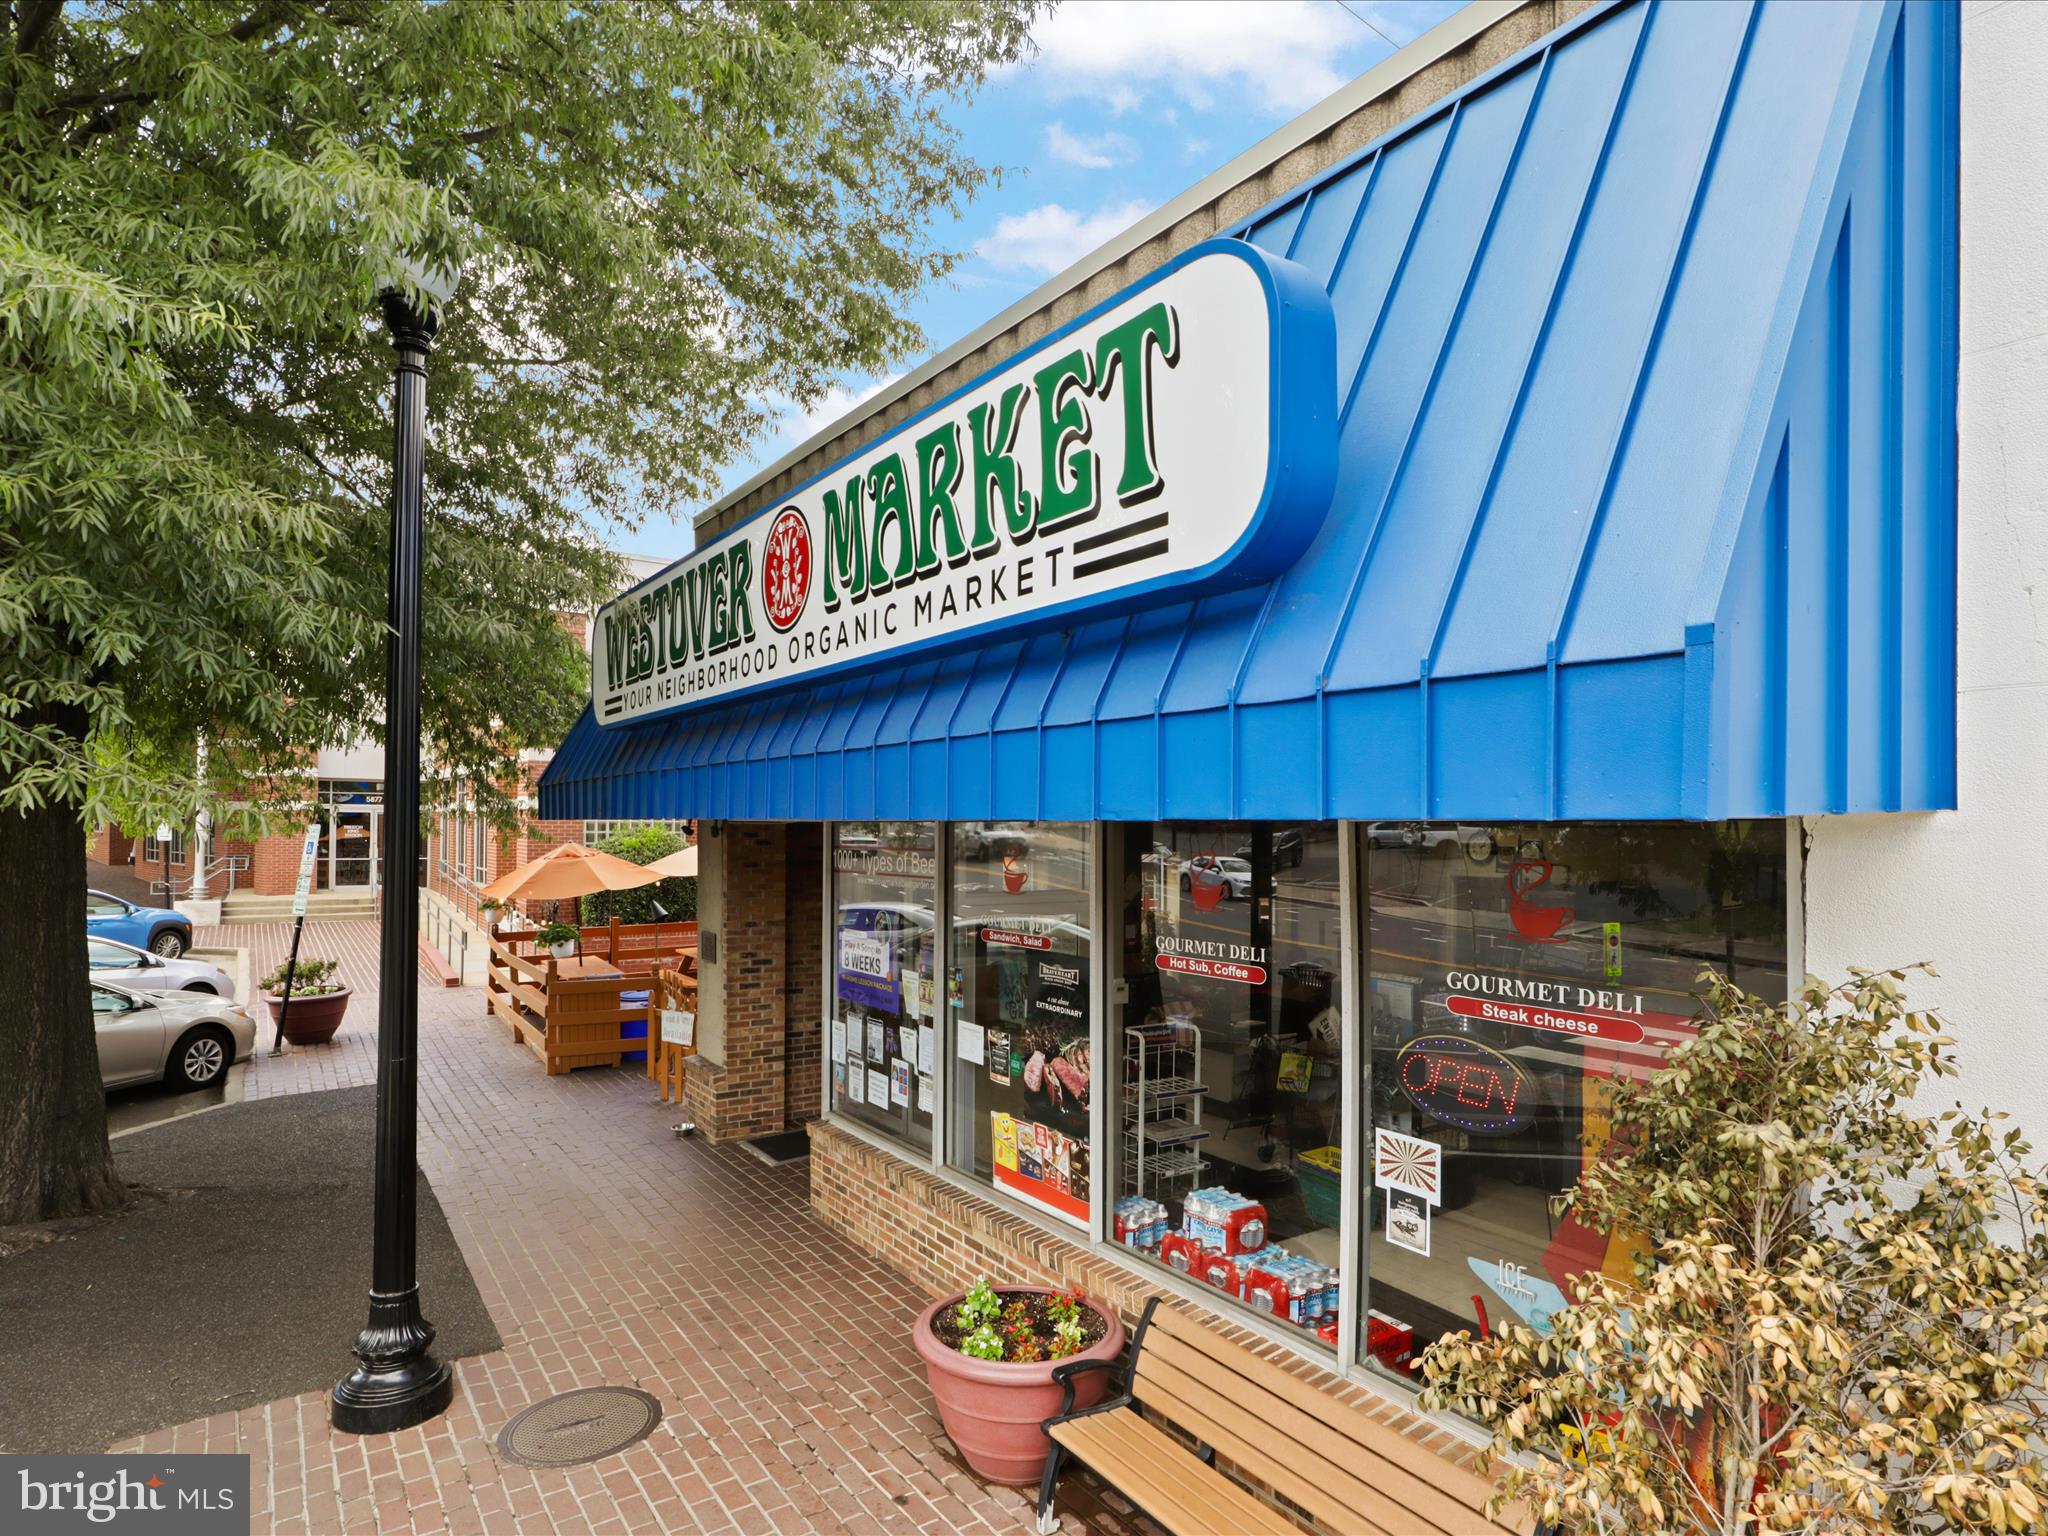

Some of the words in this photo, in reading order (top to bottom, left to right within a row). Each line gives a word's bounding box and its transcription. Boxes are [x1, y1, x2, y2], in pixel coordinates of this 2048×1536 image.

[822, 302, 1181, 614] MARKET
[604, 538, 755, 692] WESTOVER
[623, 684, 652, 712] YOUR
[657, 644, 778, 703] NEIGHBORHOOD
[788, 602, 898, 664] ORGANIC
[914, 546, 1064, 627] MARKET
[833, 849, 858, 870] 1000+
[861, 850, 893, 876] Types
[896, 852, 909, 873] of
[911, 852, 936, 874] Bee
[989, 930, 1022, 944] Sandwich,
[1023, 934, 1043, 948] Salad
[1155, 935, 1226, 957] GOURMET
[1229, 944, 1266, 963] DELI
[844, 951, 850, 968] 8
[851, 953, 881, 975] WEEKS
[1169, 957, 1187, 969] Hot
[1189, 960, 1211, 975] Sub,
[1213, 963, 1249, 979] Coffee
[1036, 1000, 1083, 1018] EXTRAORDINARY
[1445, 971, 1570, 1005] GOURMET
[1577, 987, 1645, 1016] DELI
[1482, 1002, 1529, 1025] Steak
[1534, 1008, 1599, 1034] cheese
[1401, 1053, 1521, 1115] OPEN
[1498, 1258, 1528, 1291] ICE
